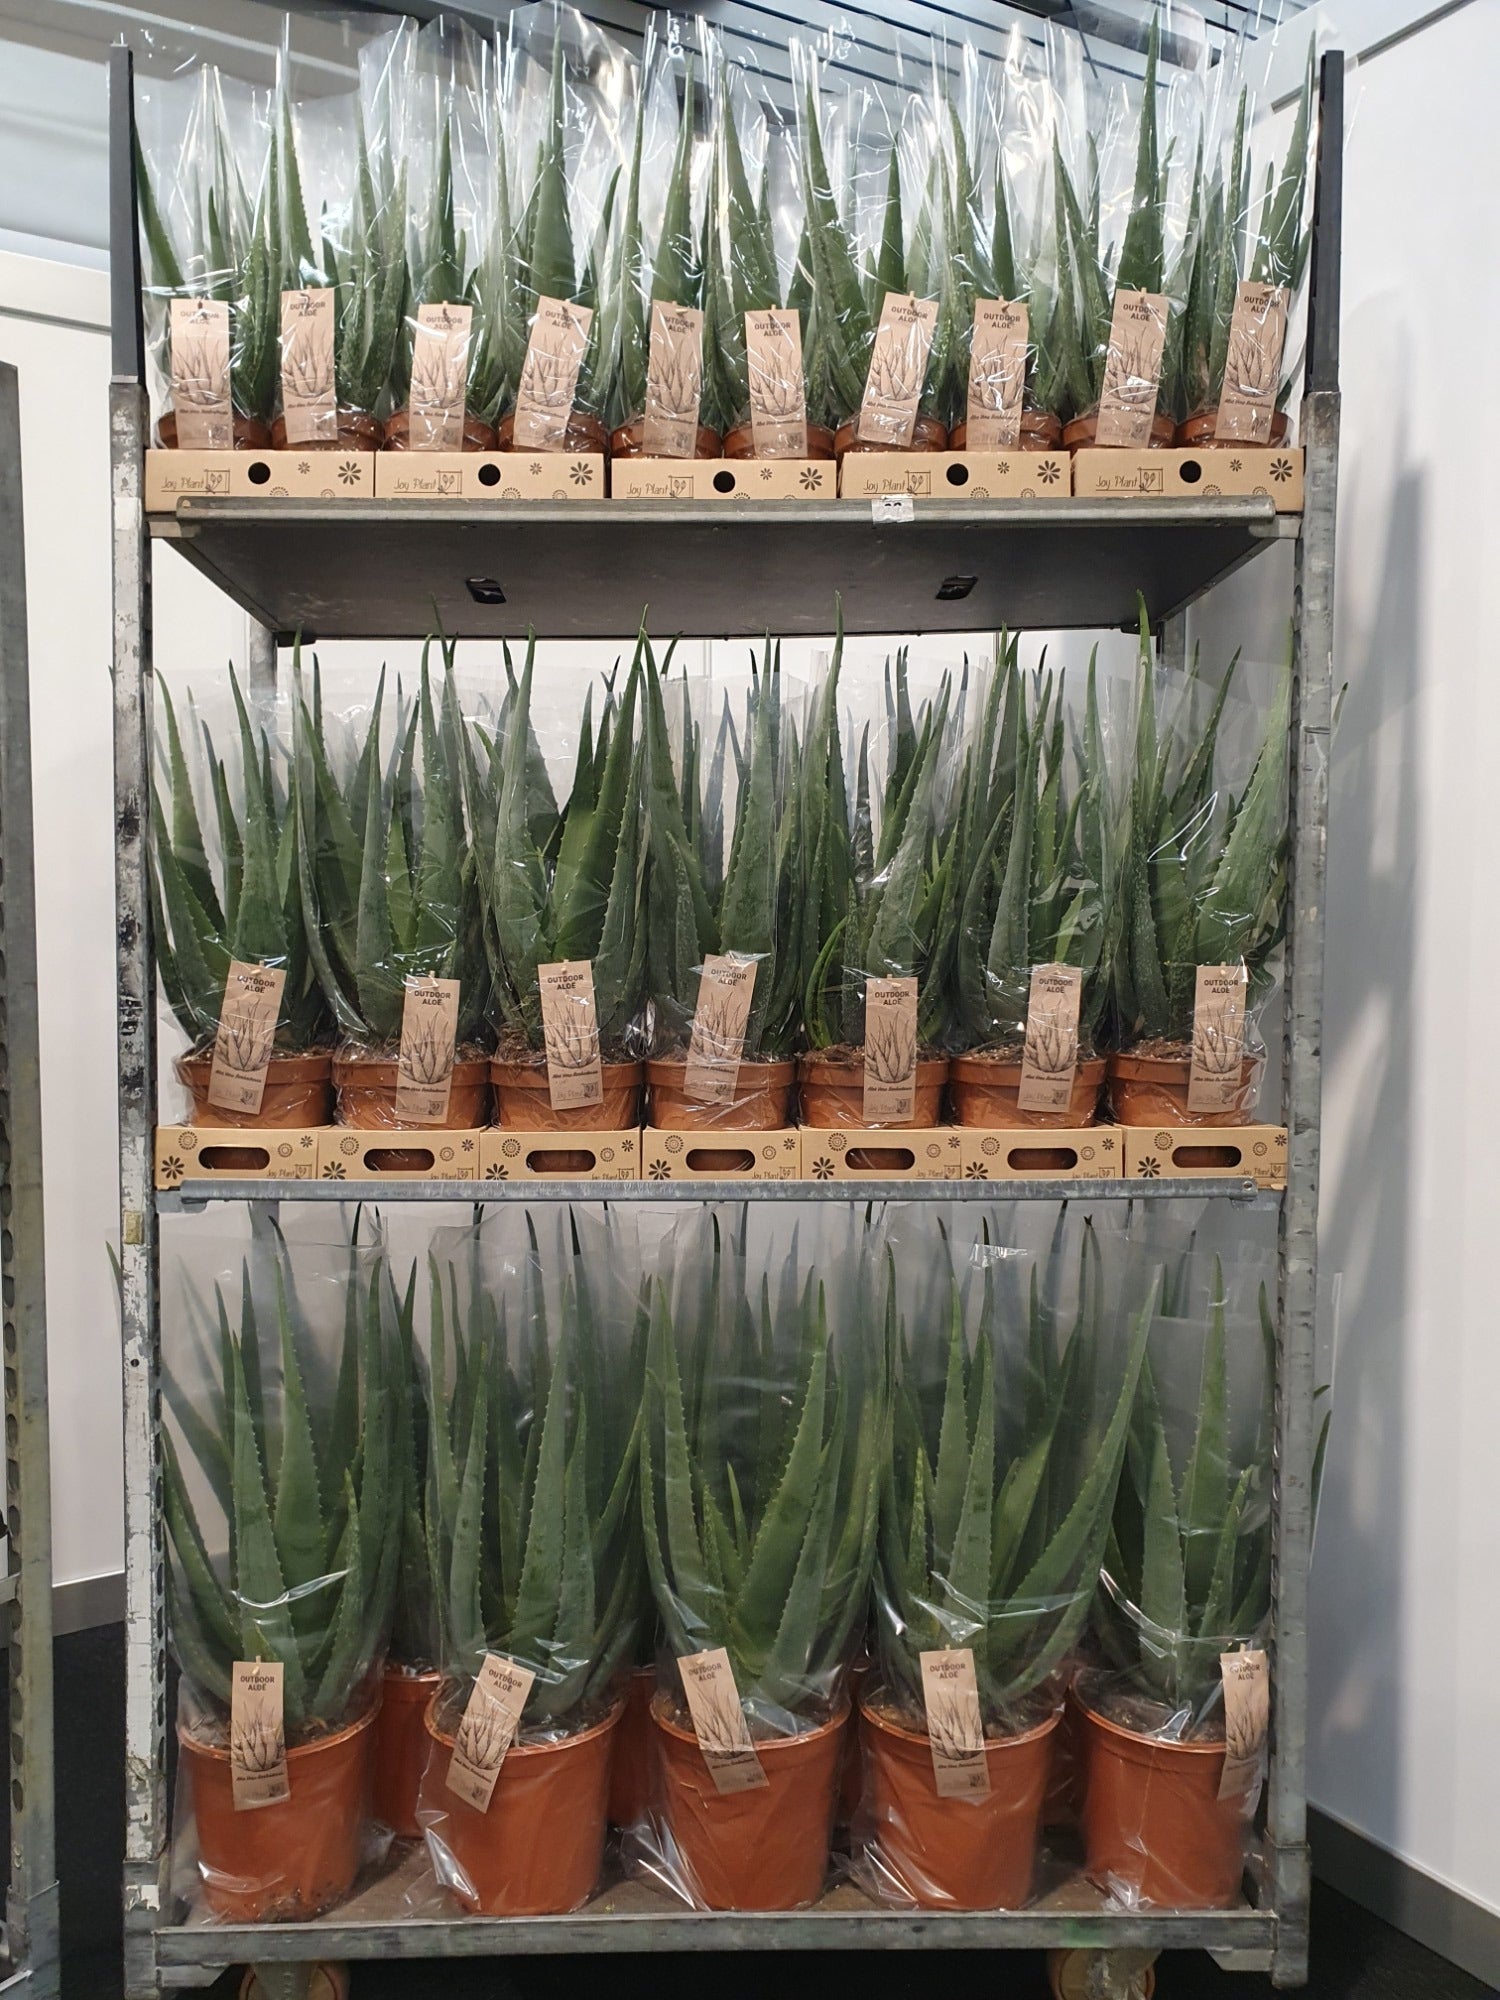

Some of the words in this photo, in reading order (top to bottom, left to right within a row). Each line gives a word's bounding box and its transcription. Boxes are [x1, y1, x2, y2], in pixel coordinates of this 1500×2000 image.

[891, 306, 929, 319] OUTDOOR
[1250, 304, 1268, 314] ALO
[545, 310, 582, 324] OUTDOR
[983, 312, 1021, 322] OUTDOOR
[1130, 312, 1151, 322] ALOE
[991, 321, 1012, 329] ALOE
[160, 478, 177, 491] Joy
[180, 477, 204, 489] Plant
[393, 478, 409, 491] Joy
[412, 477, 437, 490] Plant
[863, 478, 879, 492] Joy
[882, 477, 906, 490] Plant
[1095, 476, 1111, 489] Joy
[1114, 475, 1138, 488] Plant
[626, 482, 642, 495] Joy
[645, 480, 669, 494] Plant
[547, 974, 584, 984] OUTDOOR
[710, 968, 747, 981] OUTDOOR
[236, 975, 275, 988] OUTDOOR
[556, 982, 576, 990] ALOE
[717, 977, 738, 987] ALOE
[1038, 978, 1073, 986] OUTDOOR
[244, 984, 266, 994] ALOE
[1046, 986, 1065, 994] ALOE
[1211, 986, 1230, 994] ALOE
[414, 990, 451, 999] OUTDOOR
[421, 998, 443, 1006] ALOE
[883, 998, 902, 1006] ALOE
[688, 1663, 722, 1676] OUTDOOR
[929, 1663, 966, 1672] OUTDOOR
[240, 1675, 275, 1683] OUTDOOR
[488, 1669, 523, 1688] OUTDOOR
[698, 1673, 716, 1682] ALOE
[939, 1671, 959, 1679] ALOE
[1237, 1673, 1255, 1681] ALOE
[247, 1683, 267, 1691] ALOE
[493, 1679, 513, 1692] ALOE
